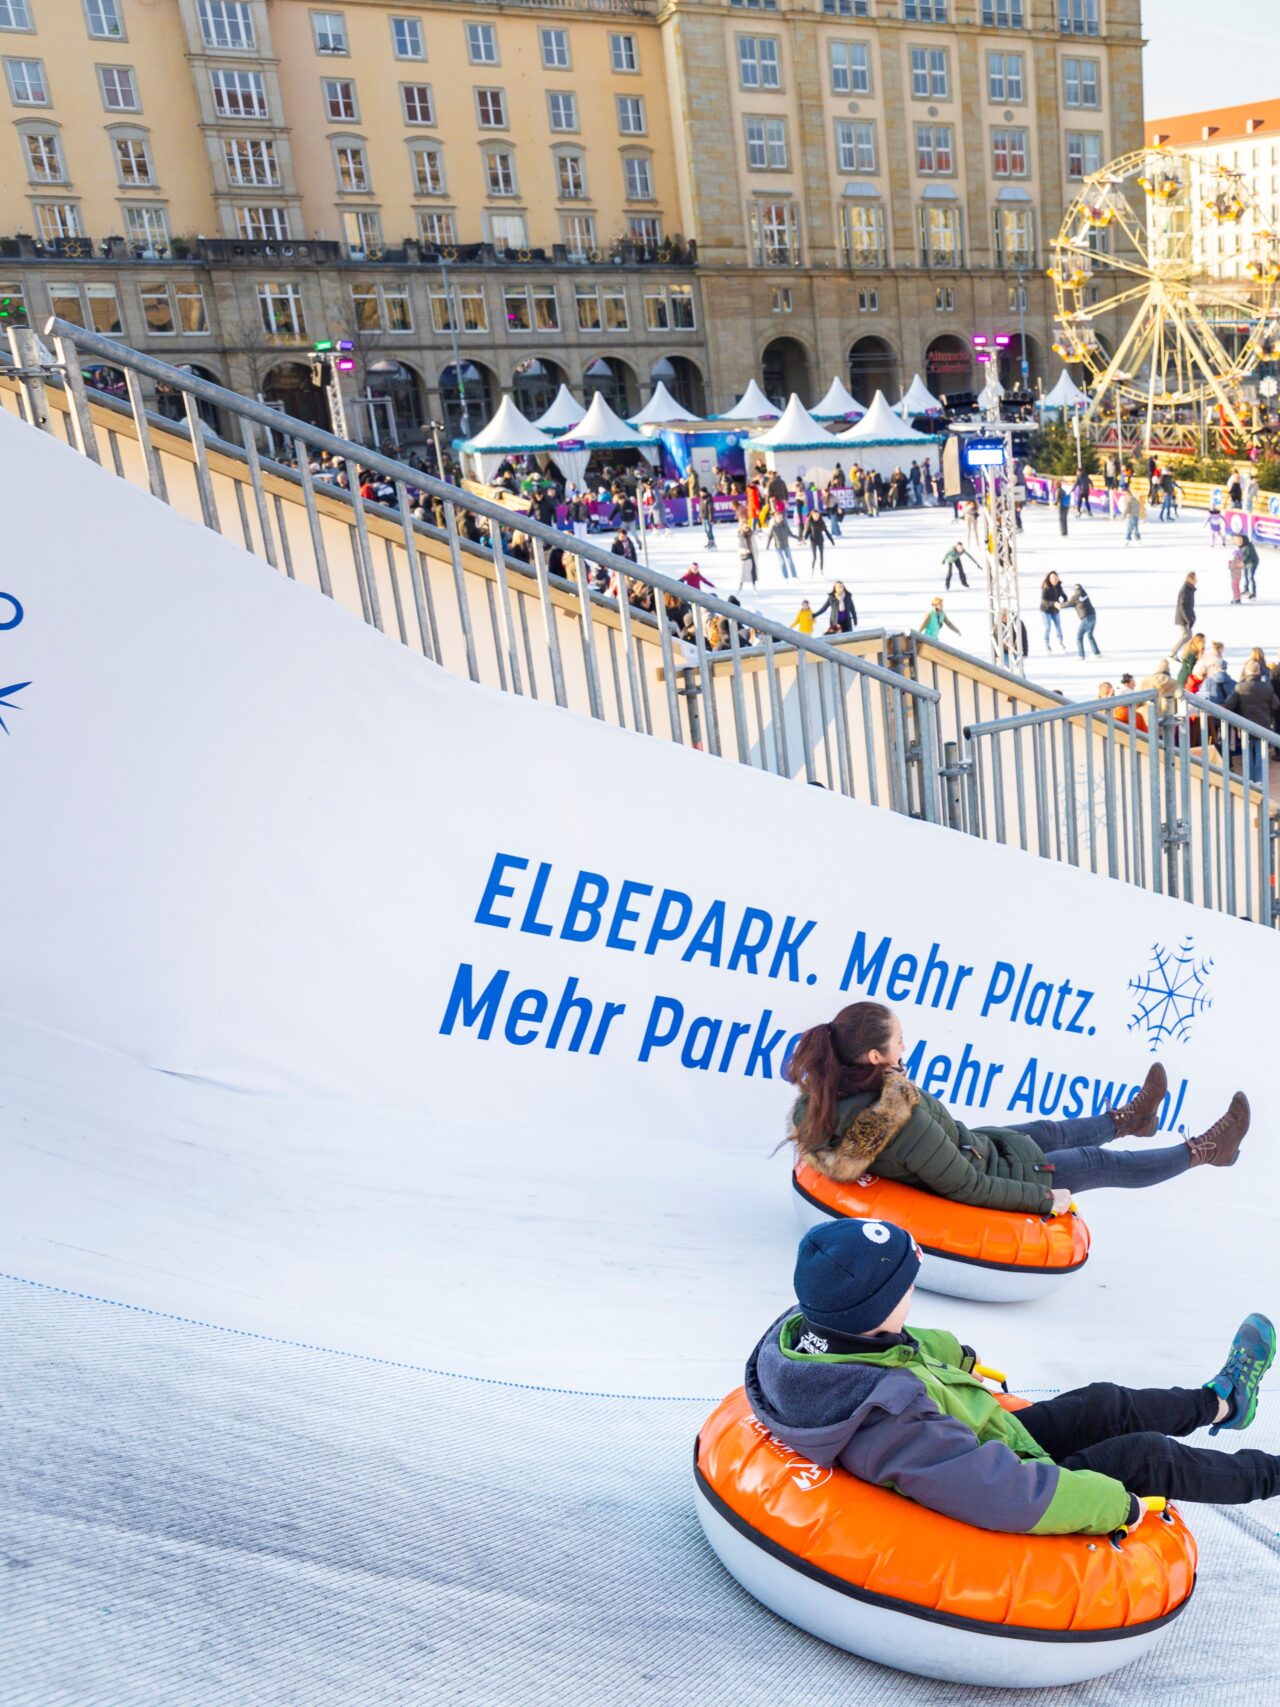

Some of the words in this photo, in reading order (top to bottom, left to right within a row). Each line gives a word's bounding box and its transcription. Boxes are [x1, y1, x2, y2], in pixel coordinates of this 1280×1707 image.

[439, 963, 626, 1064] Mehr
[475, 853, 816, 986] ELBEPARK.
[840, 931, 973, 1011] Mehr
[981, 961, 1095, 1036] Platz.
